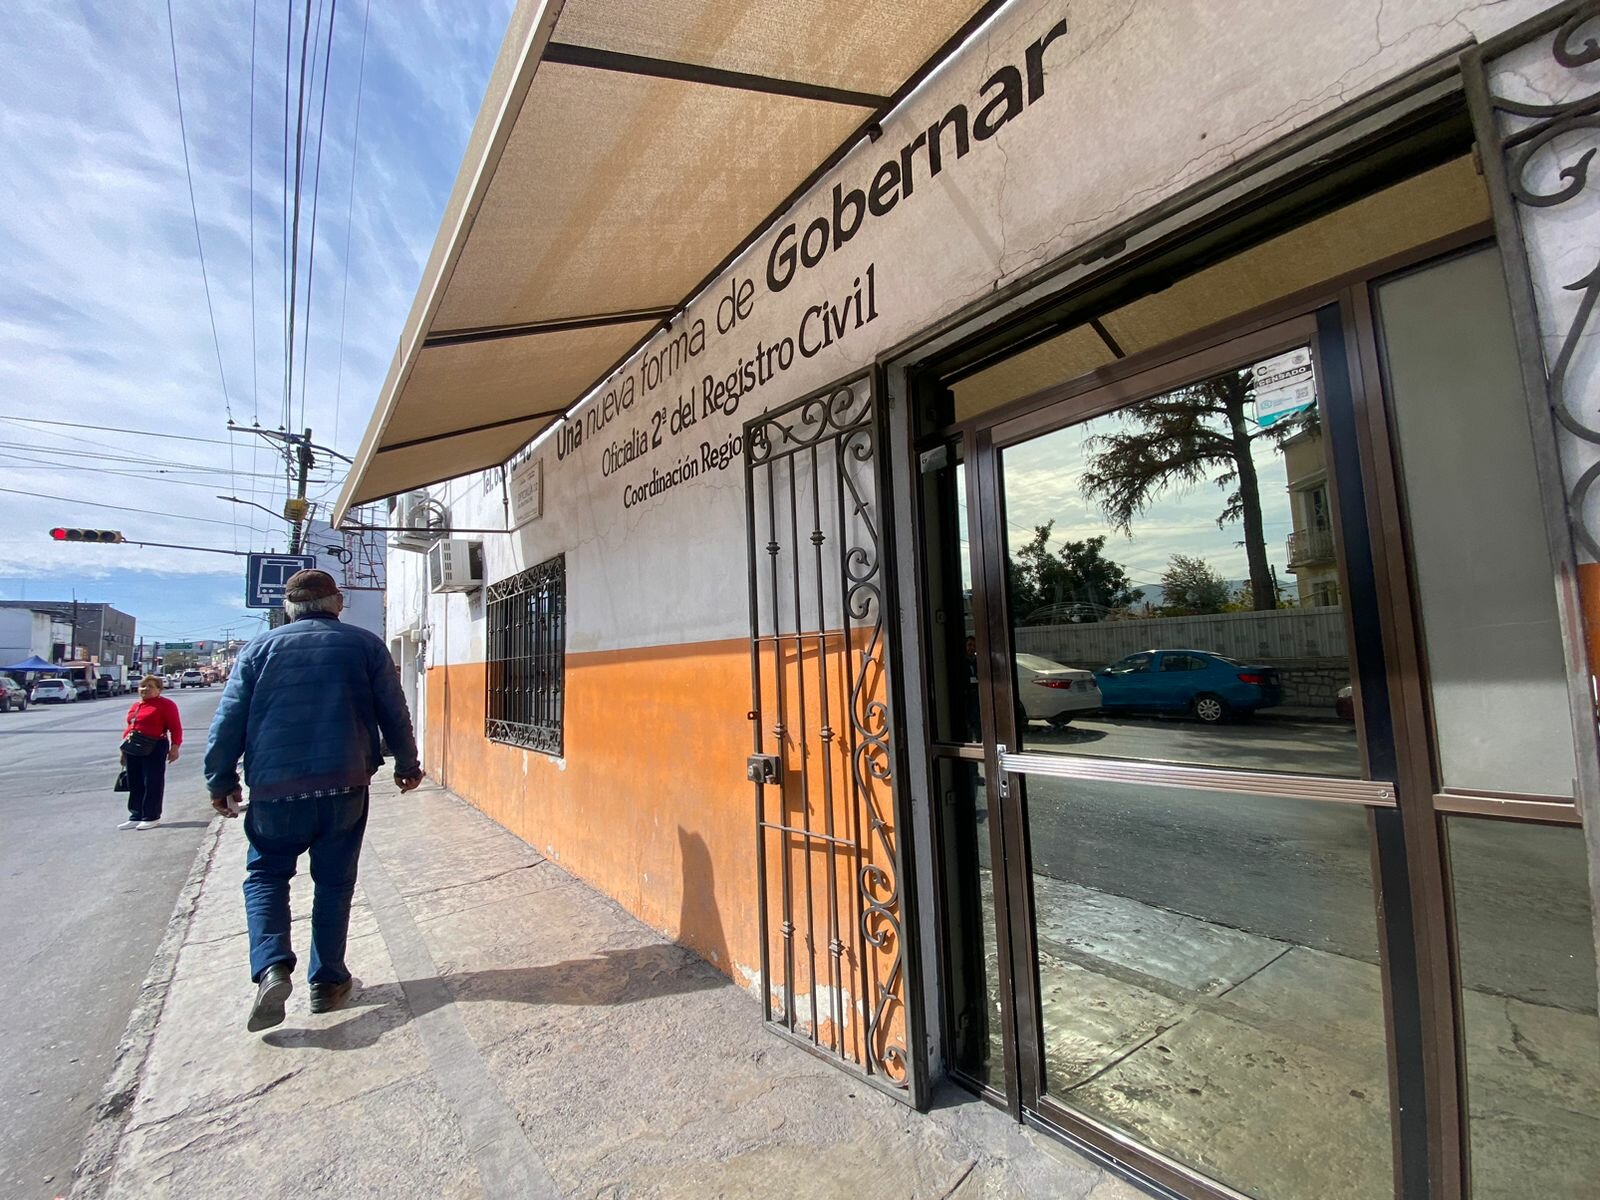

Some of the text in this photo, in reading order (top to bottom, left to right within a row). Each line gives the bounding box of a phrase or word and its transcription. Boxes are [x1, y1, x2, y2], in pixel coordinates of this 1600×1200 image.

[557, 18, 1067, 461] Una nueva forma de Gobernar
[670, 386, 697, 436] del
[702, 336, 794, 419] Registro
[798, 262, 878, 358] Civil
[1258, 366, 1307, 388] CENSADO
[623, 406, 768, 509] Coordinación Regioal
